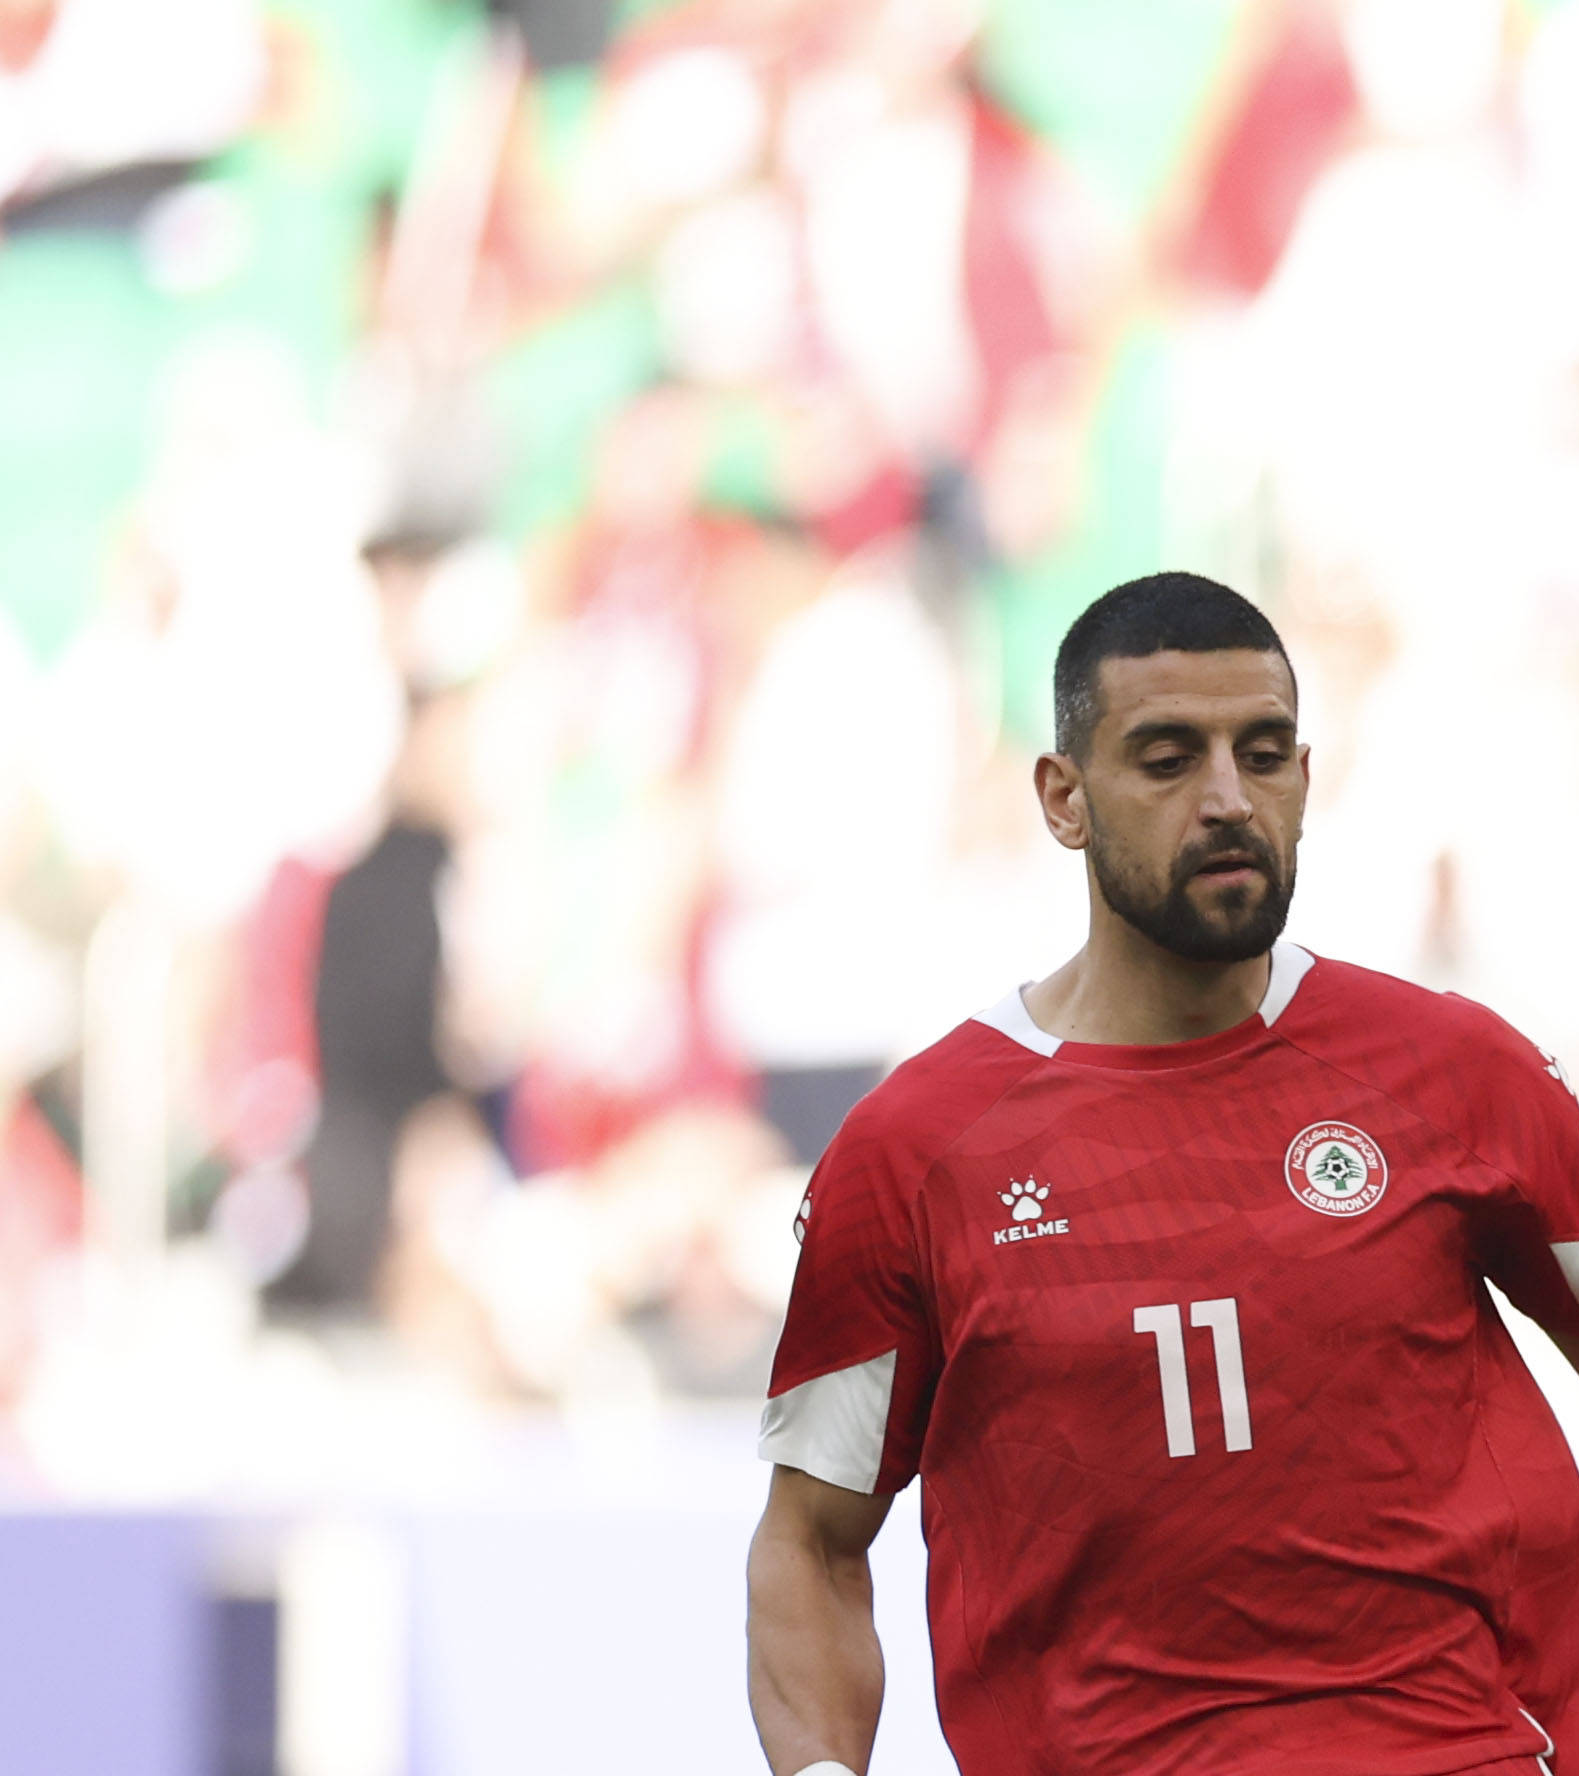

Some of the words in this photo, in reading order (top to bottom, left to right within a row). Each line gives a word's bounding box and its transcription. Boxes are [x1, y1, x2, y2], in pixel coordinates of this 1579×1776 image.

[1302, 1187, 1364, 1211] LEBANON
[993, 1219, 1069, 1245] KELME
[1133, 1297, 1252, 1457] 11
